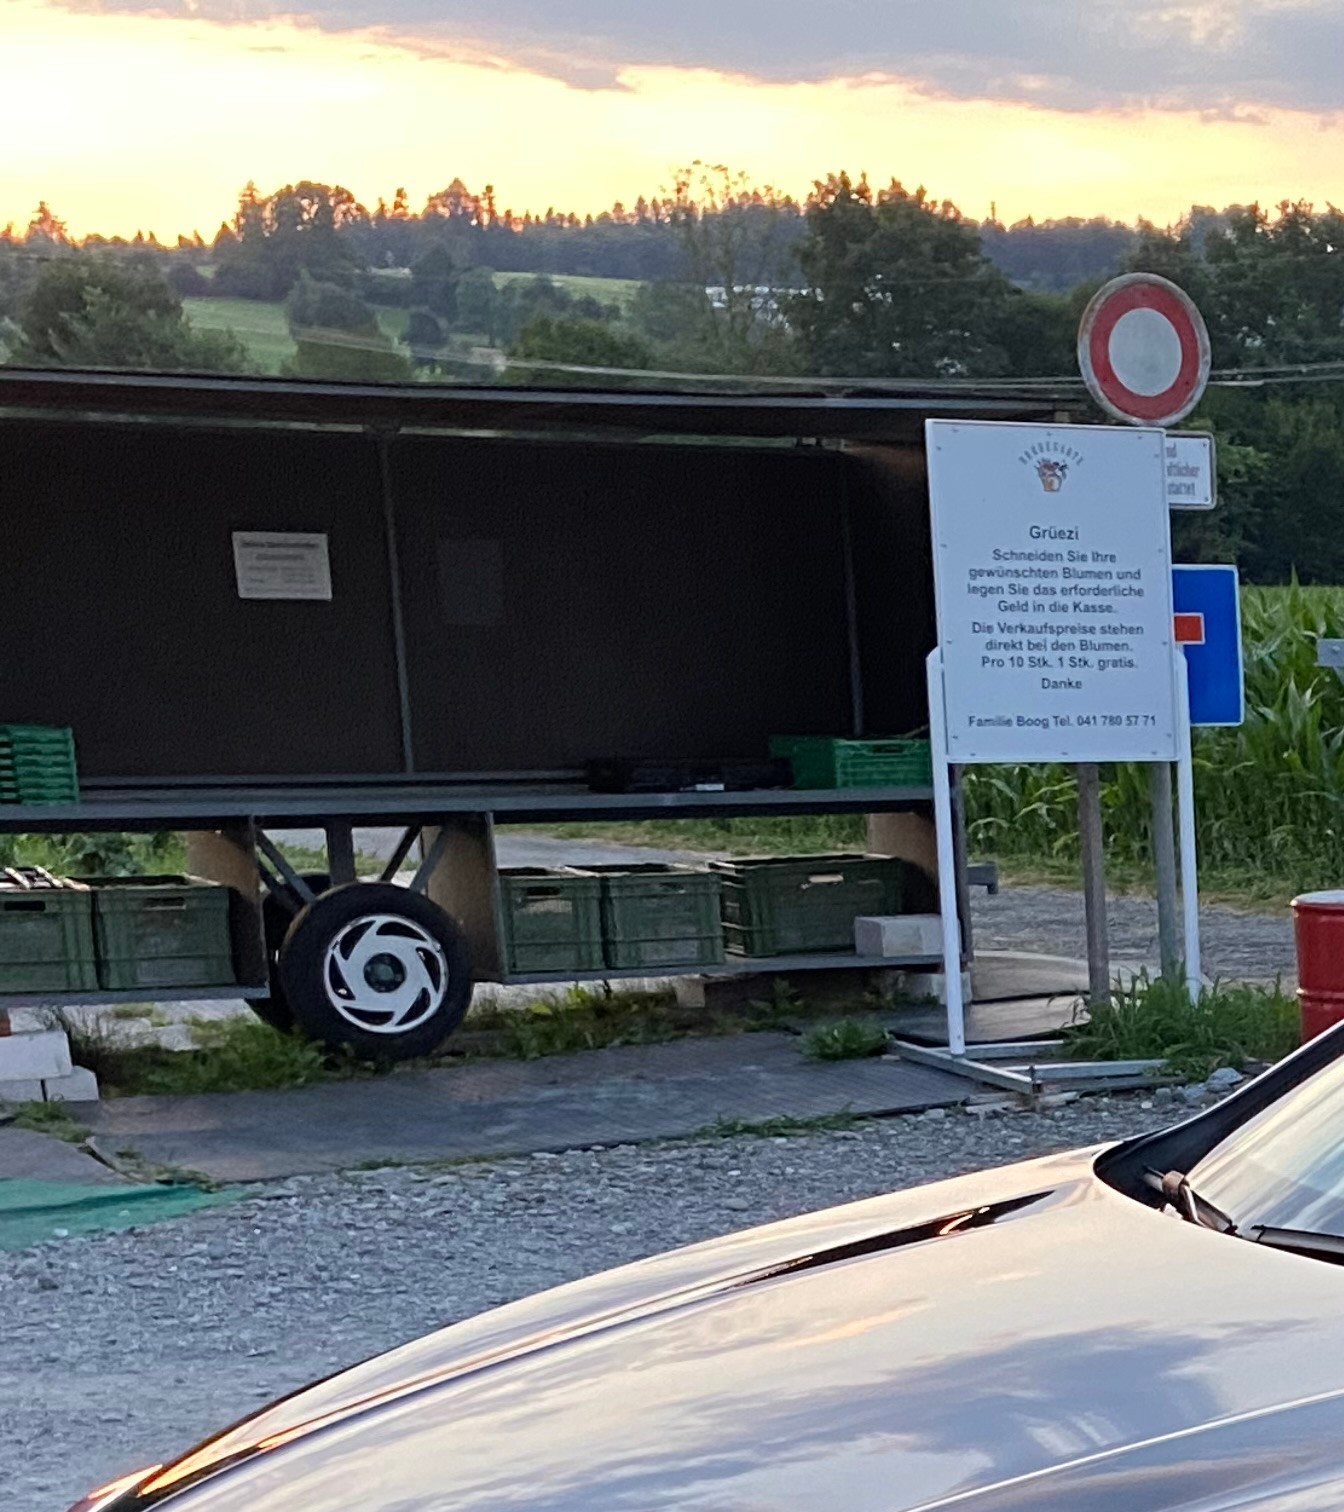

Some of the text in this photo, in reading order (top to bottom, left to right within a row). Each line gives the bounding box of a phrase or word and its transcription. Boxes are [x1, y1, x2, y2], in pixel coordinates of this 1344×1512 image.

[1029, 526, 1079, 540] Grüezi
[992, 549, 1116, 563] Schneiden Sie Ihre
[969, 567, 1141, 580] gewünschten Blumen und
[968, 584, 1144, 597] legen Sie das erforderliche
[998, 601, 1028, 612] Geld
[1033, 601, 1045, 612] in
[1049, 601, 1068, 613] die
[972, 622, 1144, 636] Die Verkaufspreise stehen
[986, 639, 1133, 651] direkt bei den Blumen.
[982, 657, 1138, 670] Pro 10 Stk. 1 Stk. gratis.
[1042, 678, 1082, 689] Danke
[969, 716, 1013, 726] Familie
[1017, 716, 1049, 728] Boog
[1053, 716, 1072, 726] Tel.
[1078, 716, 1096, 726] 041
[1126, 716, 1141, 726] 57
[1144, 716, 1156, 726] 71
